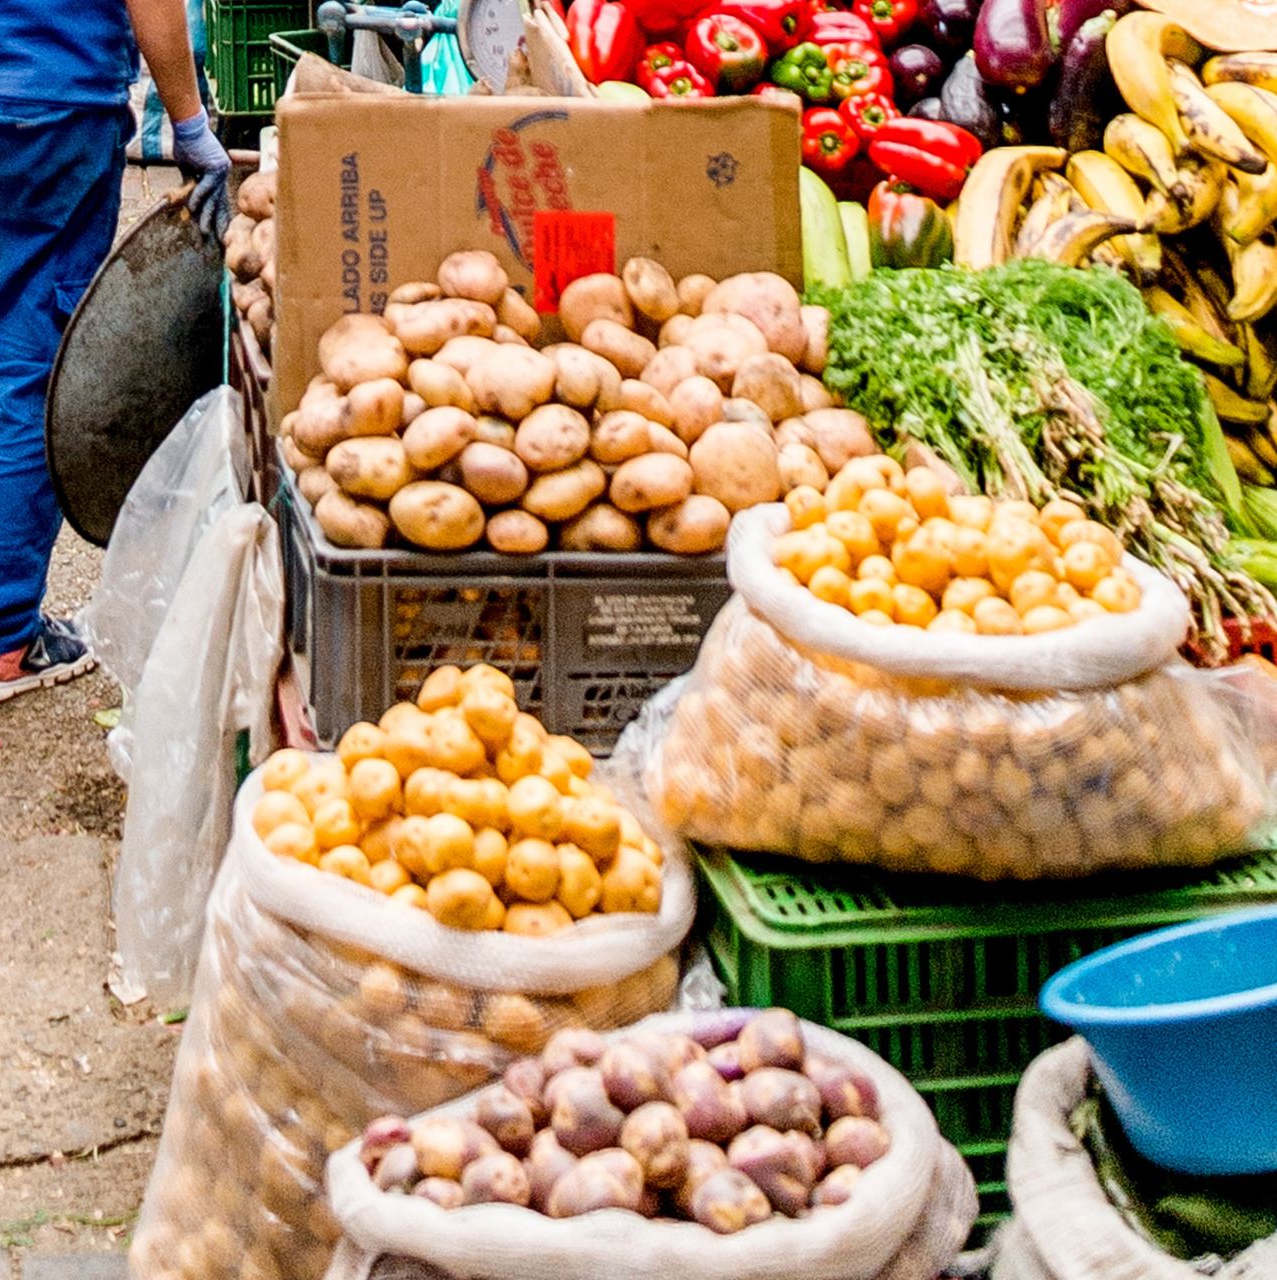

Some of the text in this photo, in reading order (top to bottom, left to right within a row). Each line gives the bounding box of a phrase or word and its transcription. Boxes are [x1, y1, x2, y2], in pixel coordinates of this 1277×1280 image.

[368, 188, 387, 222] UP
[530, 141, 571, 211] eche
[340, 151, 361, 315] LADO ARRIBA
[368, 229, 388, 284] SIDE
